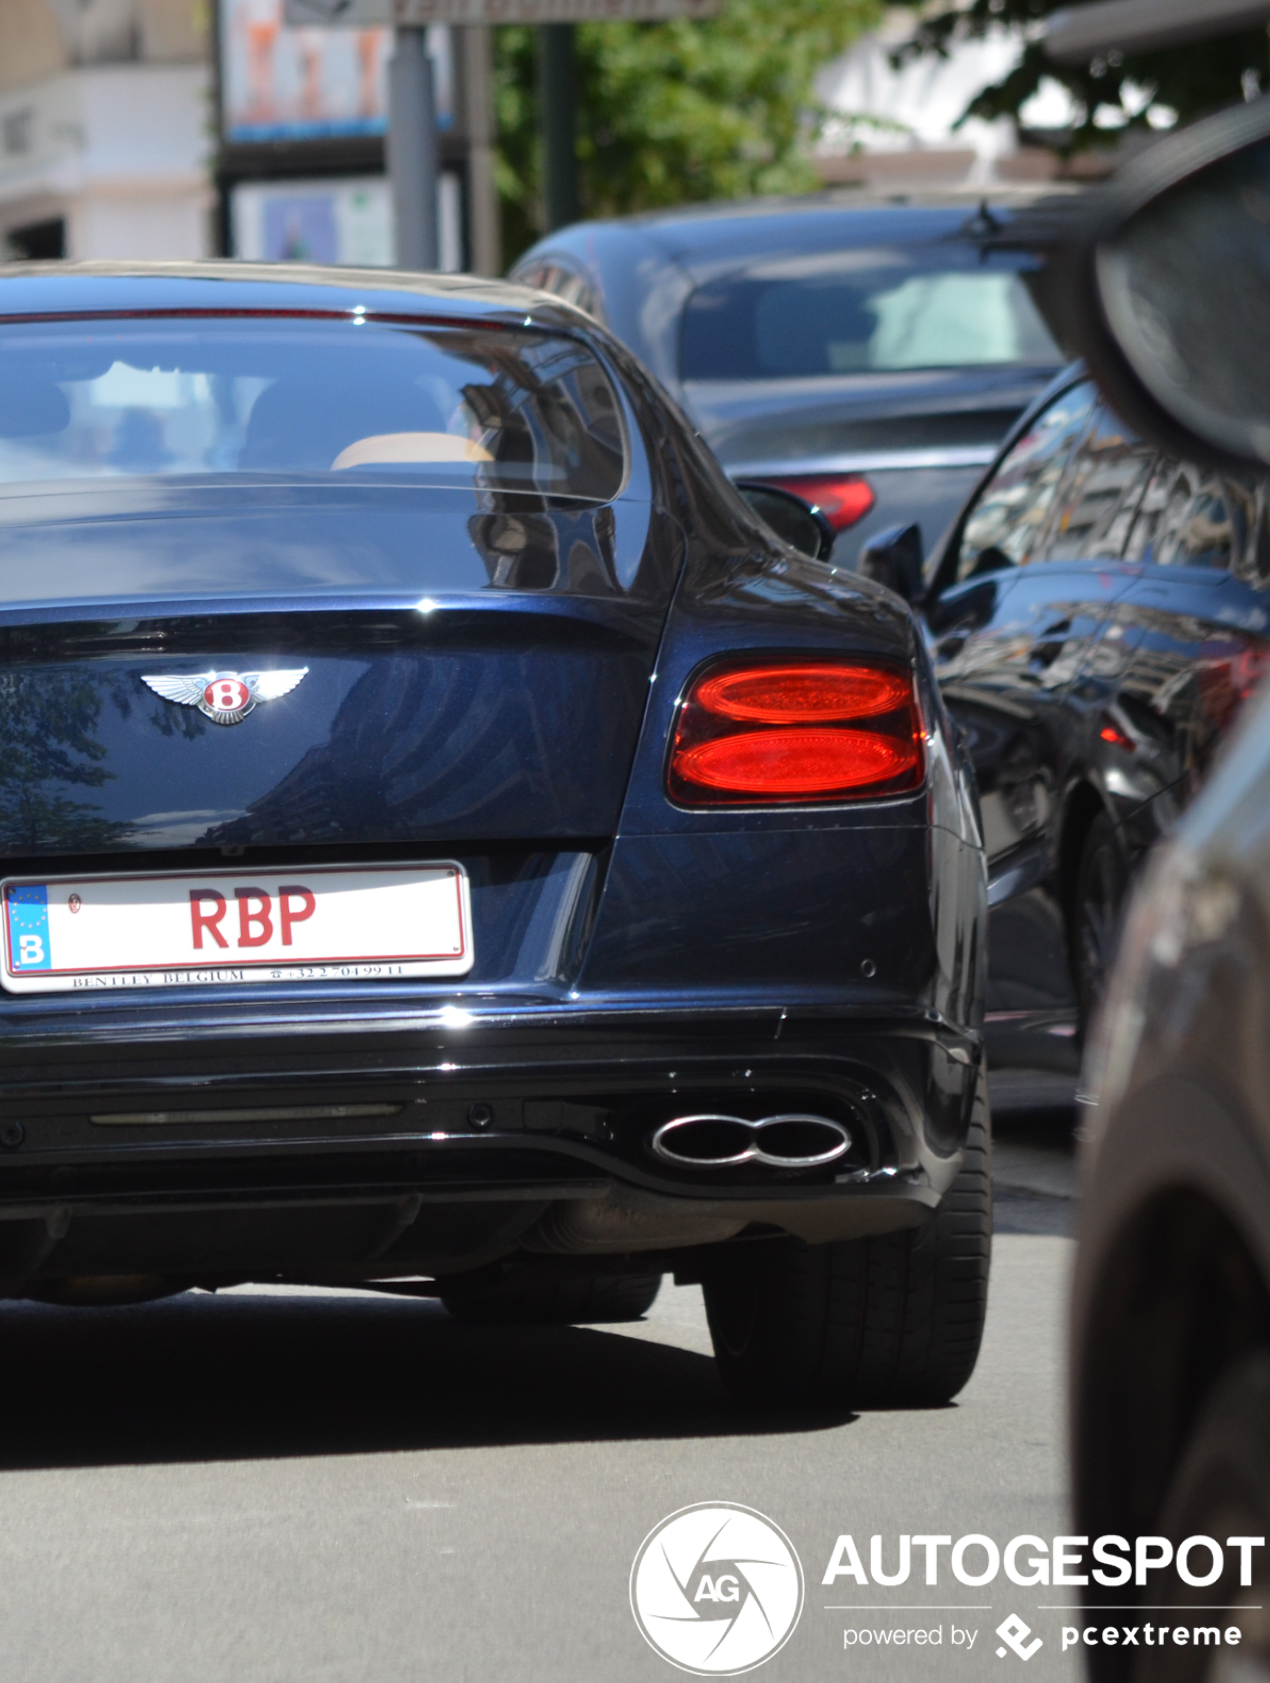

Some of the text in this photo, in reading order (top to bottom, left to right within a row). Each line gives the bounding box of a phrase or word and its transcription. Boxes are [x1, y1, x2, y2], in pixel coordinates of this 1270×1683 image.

[189, 885, 316, 949] RBP
[19, 934, 45, 964] B
[72, 974, 152, 988] BENTLEY
[163, 970, 245, 984] BELGIUM
